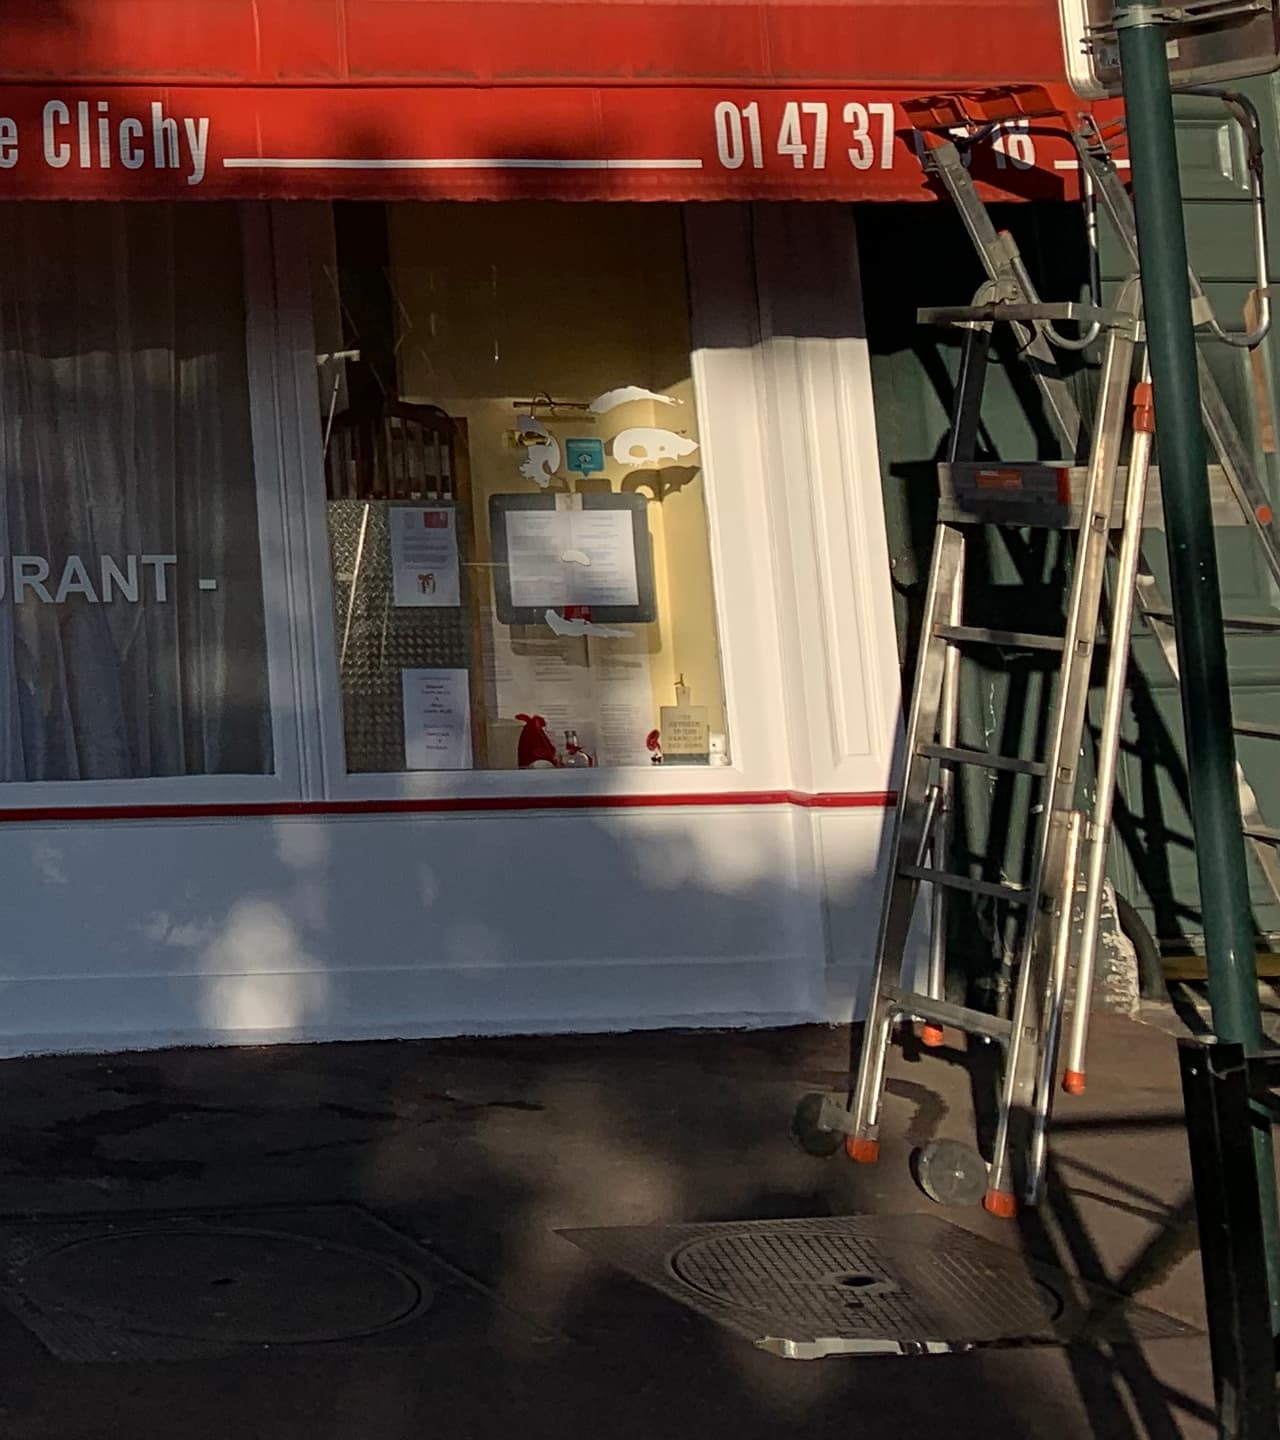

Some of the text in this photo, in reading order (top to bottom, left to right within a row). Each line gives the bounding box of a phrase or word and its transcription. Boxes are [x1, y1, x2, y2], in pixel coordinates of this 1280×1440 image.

[42, 99, 210, 185] Clichy
[714, 101, 764, 169] 01
[776, 101, 829, 169] 47
[843, 102, 895, 169] 37
